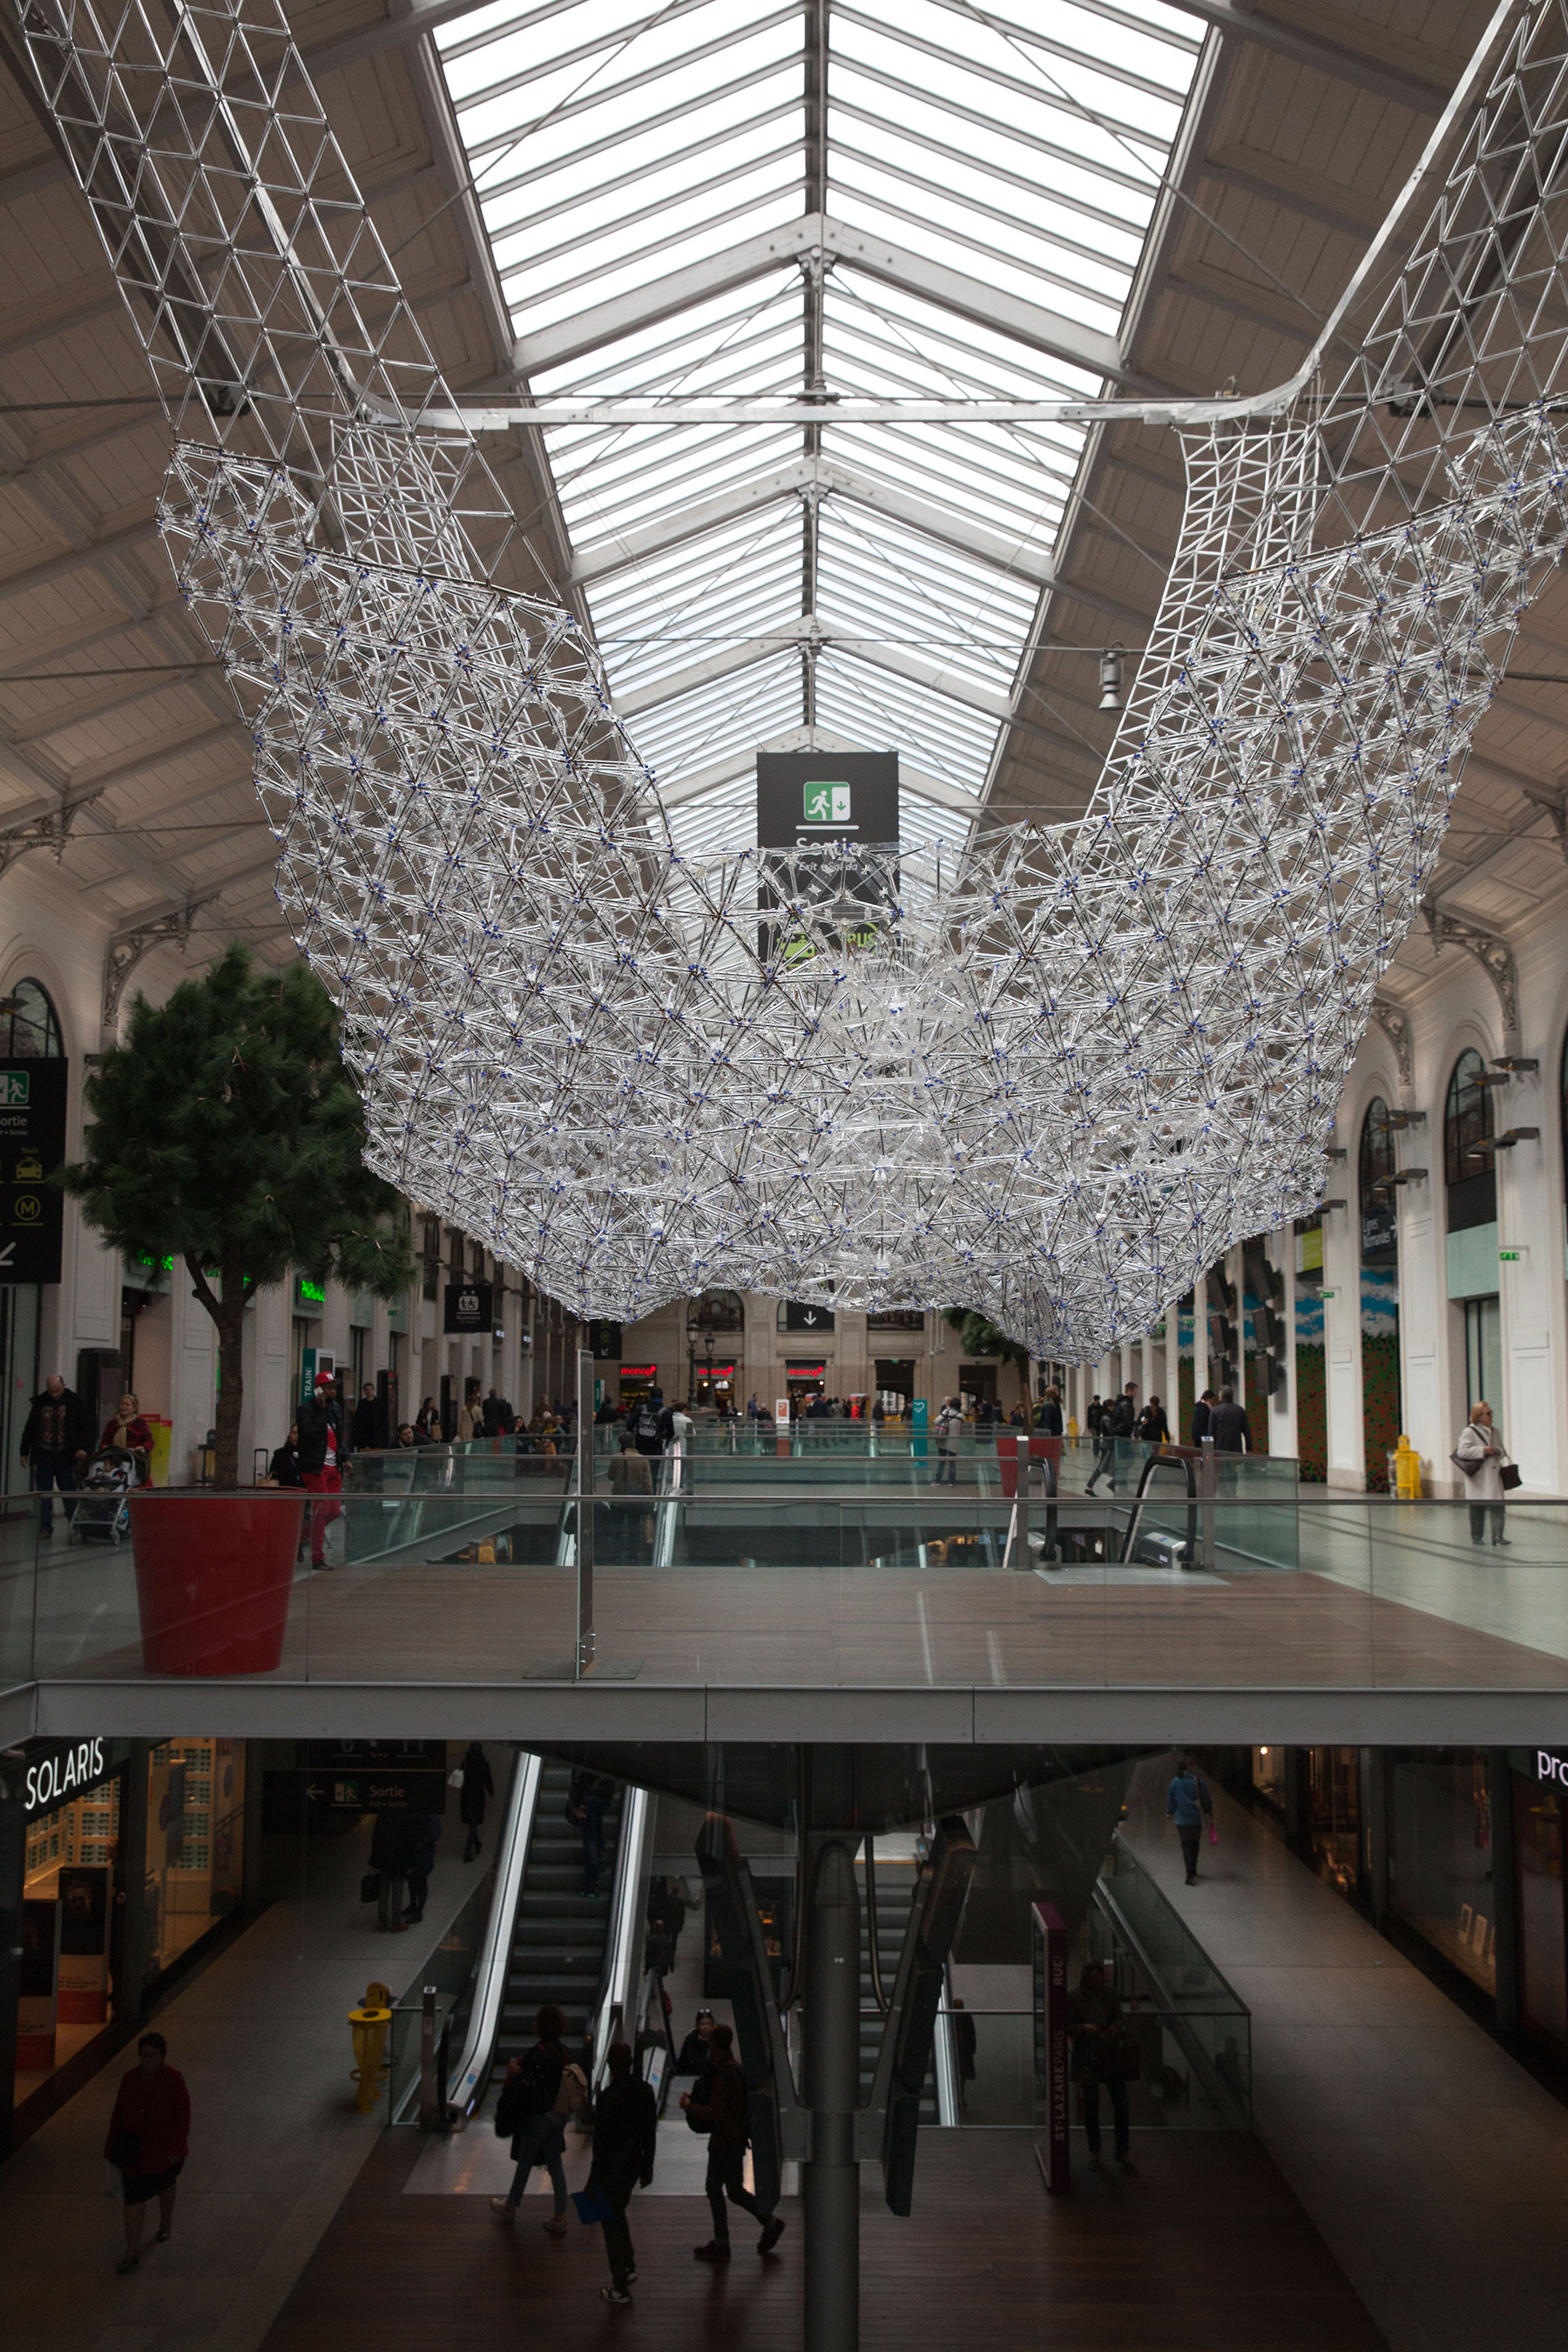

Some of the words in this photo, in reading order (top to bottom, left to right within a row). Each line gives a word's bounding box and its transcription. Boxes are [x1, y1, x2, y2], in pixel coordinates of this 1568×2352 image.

[0, 1115, 28, 1126] ortie
[25, 1736, 104, 1810] SOLARIS
[369, 1785, 405, 1798] Sortie
